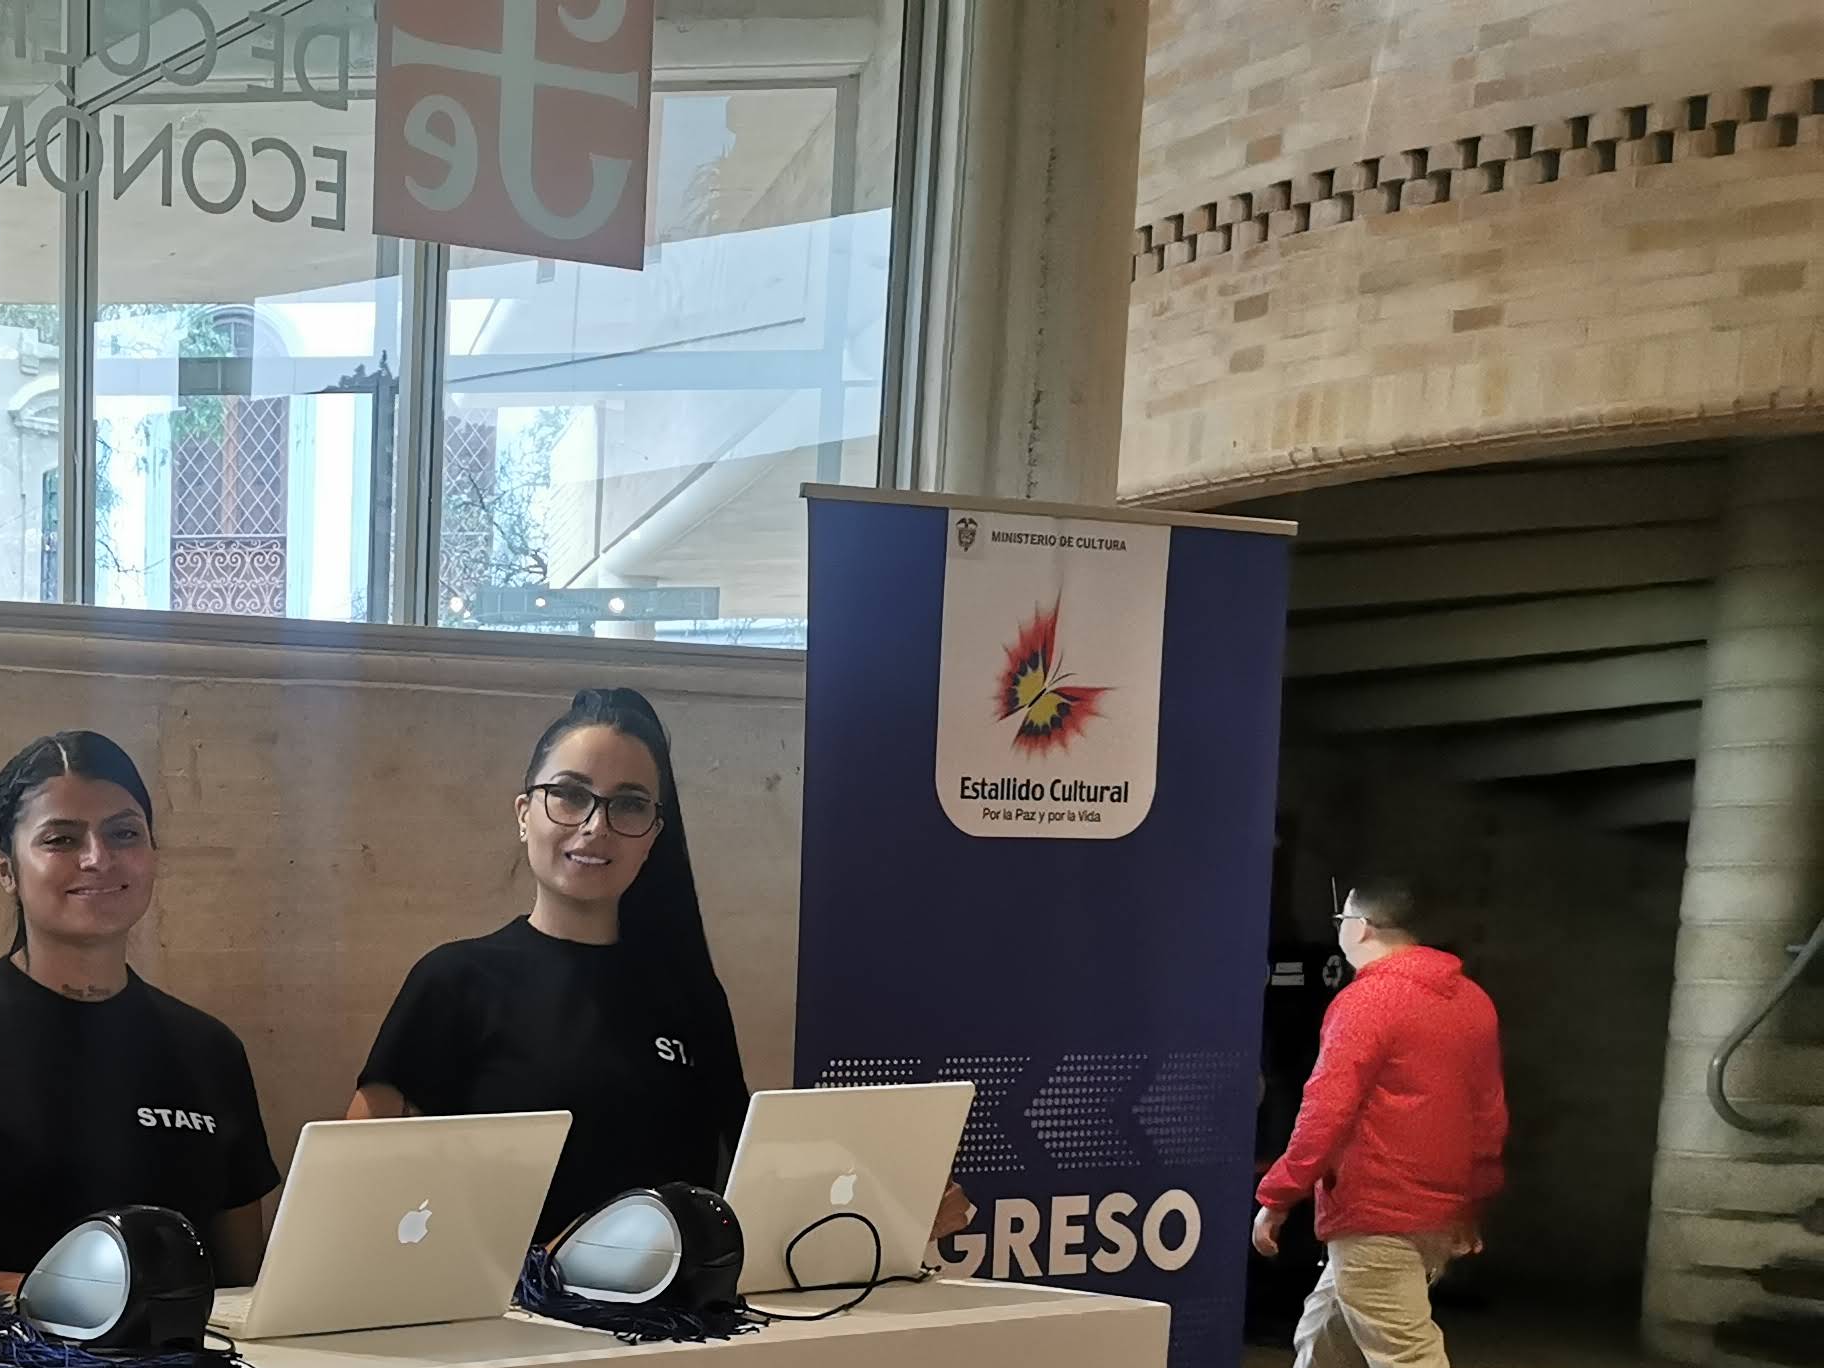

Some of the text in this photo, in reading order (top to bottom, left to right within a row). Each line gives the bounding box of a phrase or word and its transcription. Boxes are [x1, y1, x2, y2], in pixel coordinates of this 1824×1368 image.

[991, 530, 1128, 552] MINISTERIO DE CULTURA
[959, 776, 1129, 803] Estallido Cultural
[982, 808, 1001, 821] Por
[1003, 808, 1012, 821] la
[1015, 808, 1037, 822] Paz
[1047, 811, 1066, 824] por
[1067, 810, 1076, 822] la
[1078, 810, 1101, 823] Vida
[137, 1107, 217, 1134] STAFF
